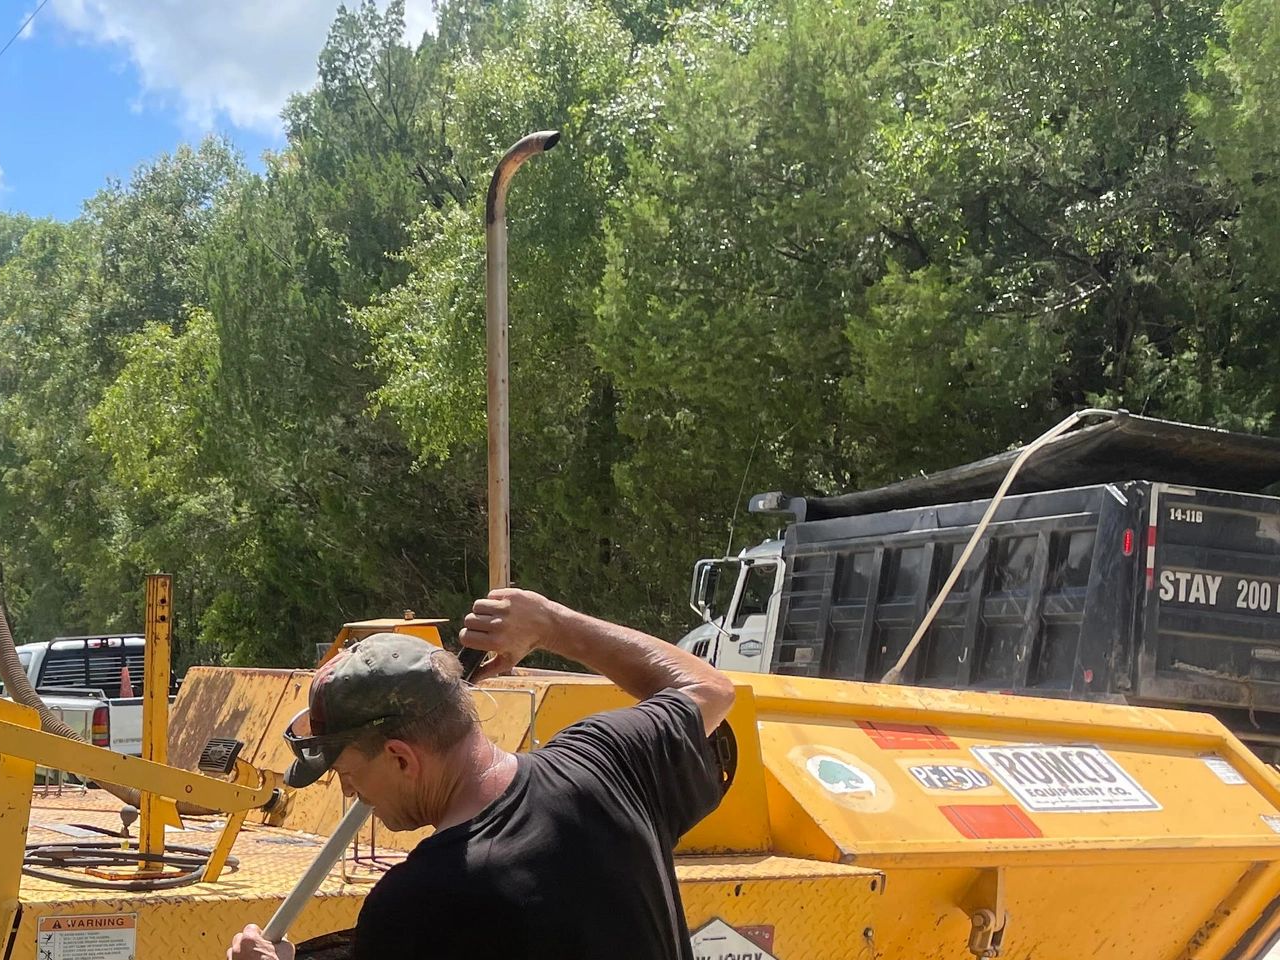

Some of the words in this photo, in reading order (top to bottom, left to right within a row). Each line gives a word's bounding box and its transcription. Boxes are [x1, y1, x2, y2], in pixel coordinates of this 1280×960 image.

[1160, 570, 1222, 606] STAY
[1236, 580, 1271, 612] 200
[989, 751, 1117, 785] ROMCO
[1025, 787, 1106, 798] EQUIPMENT
[1107, 786, 1132, 796] CO.
[66, 917, 124, 928] WARNING
